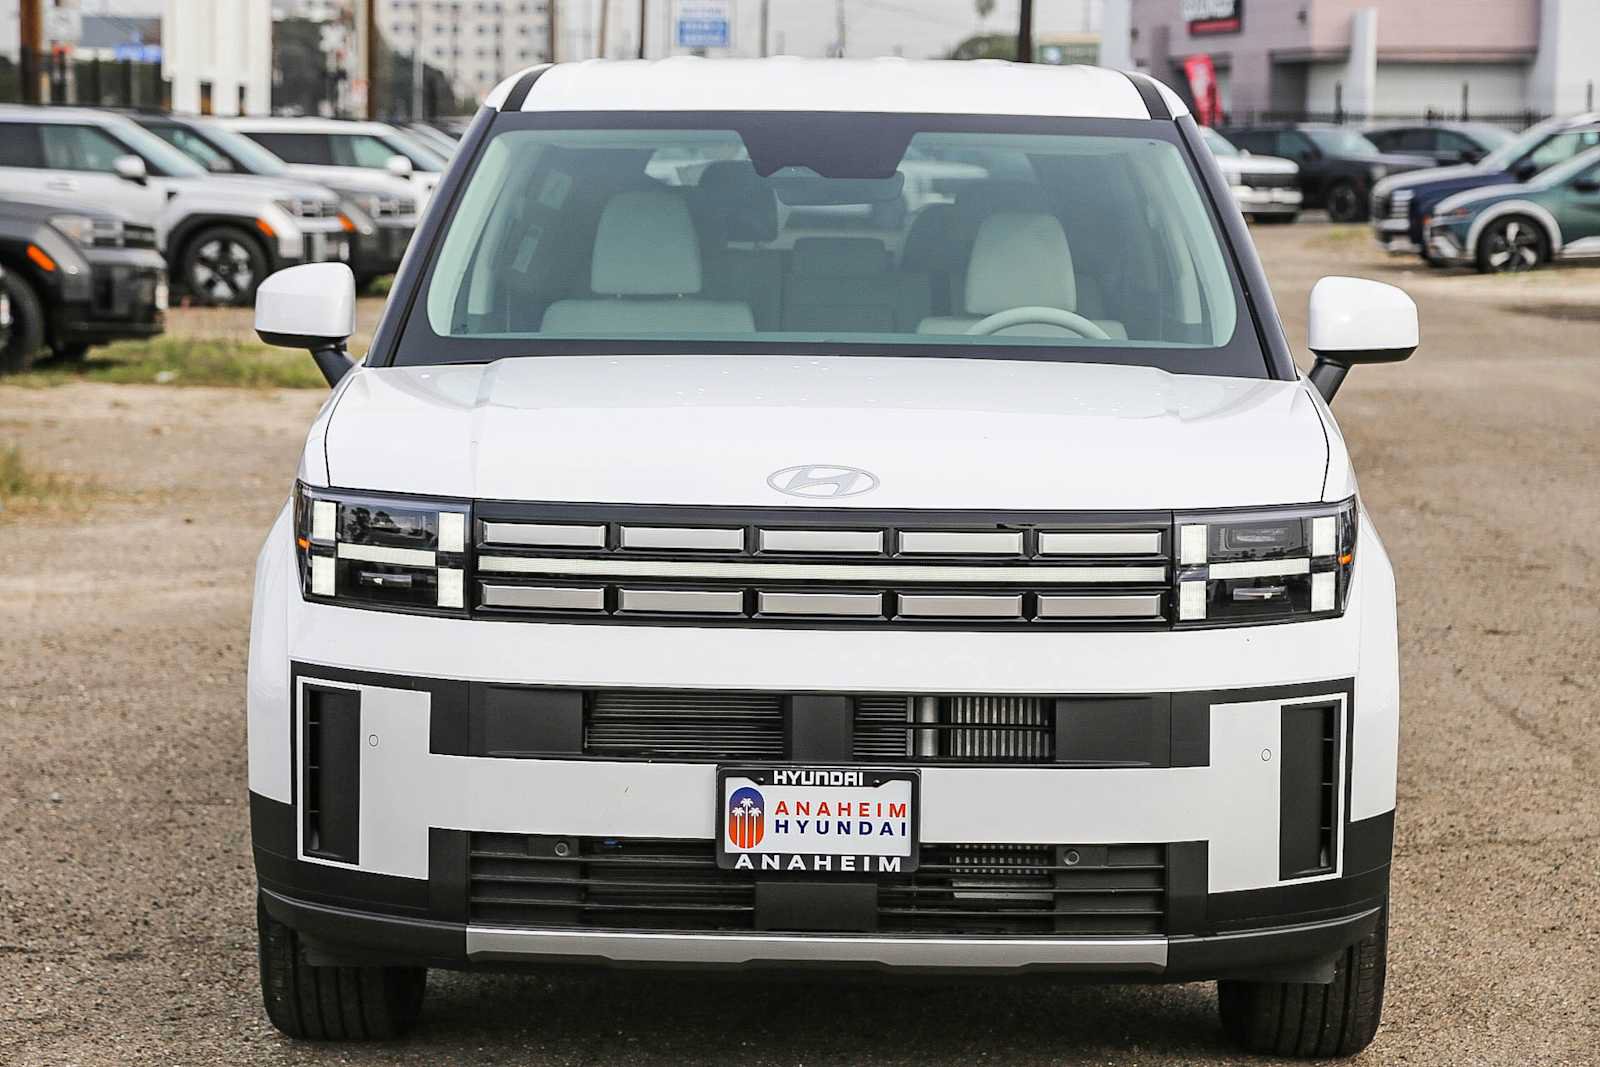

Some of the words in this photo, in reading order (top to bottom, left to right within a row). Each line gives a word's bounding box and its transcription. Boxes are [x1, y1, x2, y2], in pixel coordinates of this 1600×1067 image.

[774, 770, 863, 787] HYUNDAI
[775, 800, 906, 818] ANAHEIM
[775, 819, 906, 837] HYUNDAI
[734, 854, 901, 873] ANAHEIM
